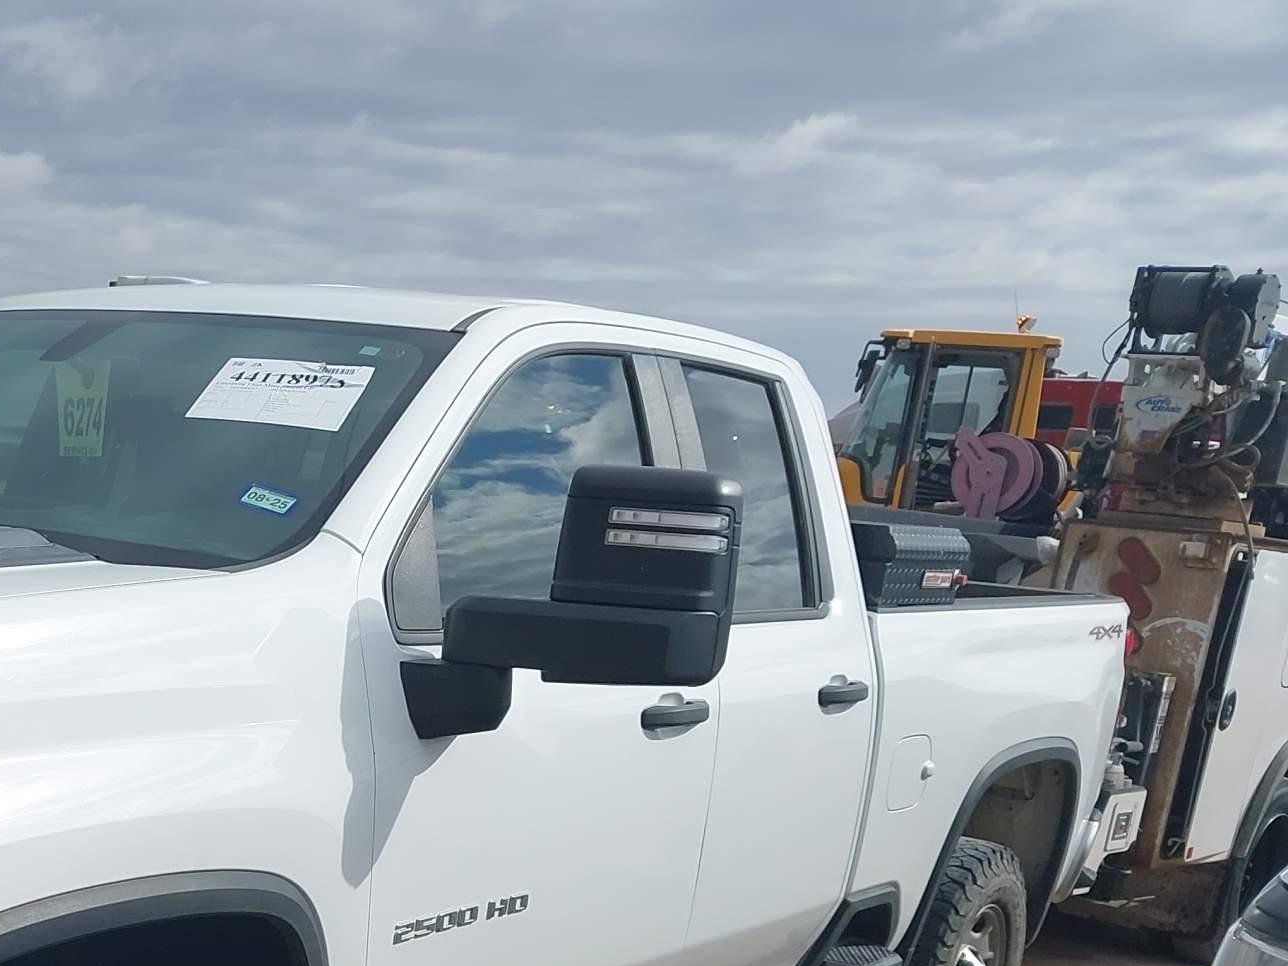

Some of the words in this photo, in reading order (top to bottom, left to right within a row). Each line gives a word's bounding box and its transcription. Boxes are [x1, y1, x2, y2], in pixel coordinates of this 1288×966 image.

[63, 397, 103, 436] 6274
[392, 906, 479, 945] 2500
[486, 894, 529, 920] HD
